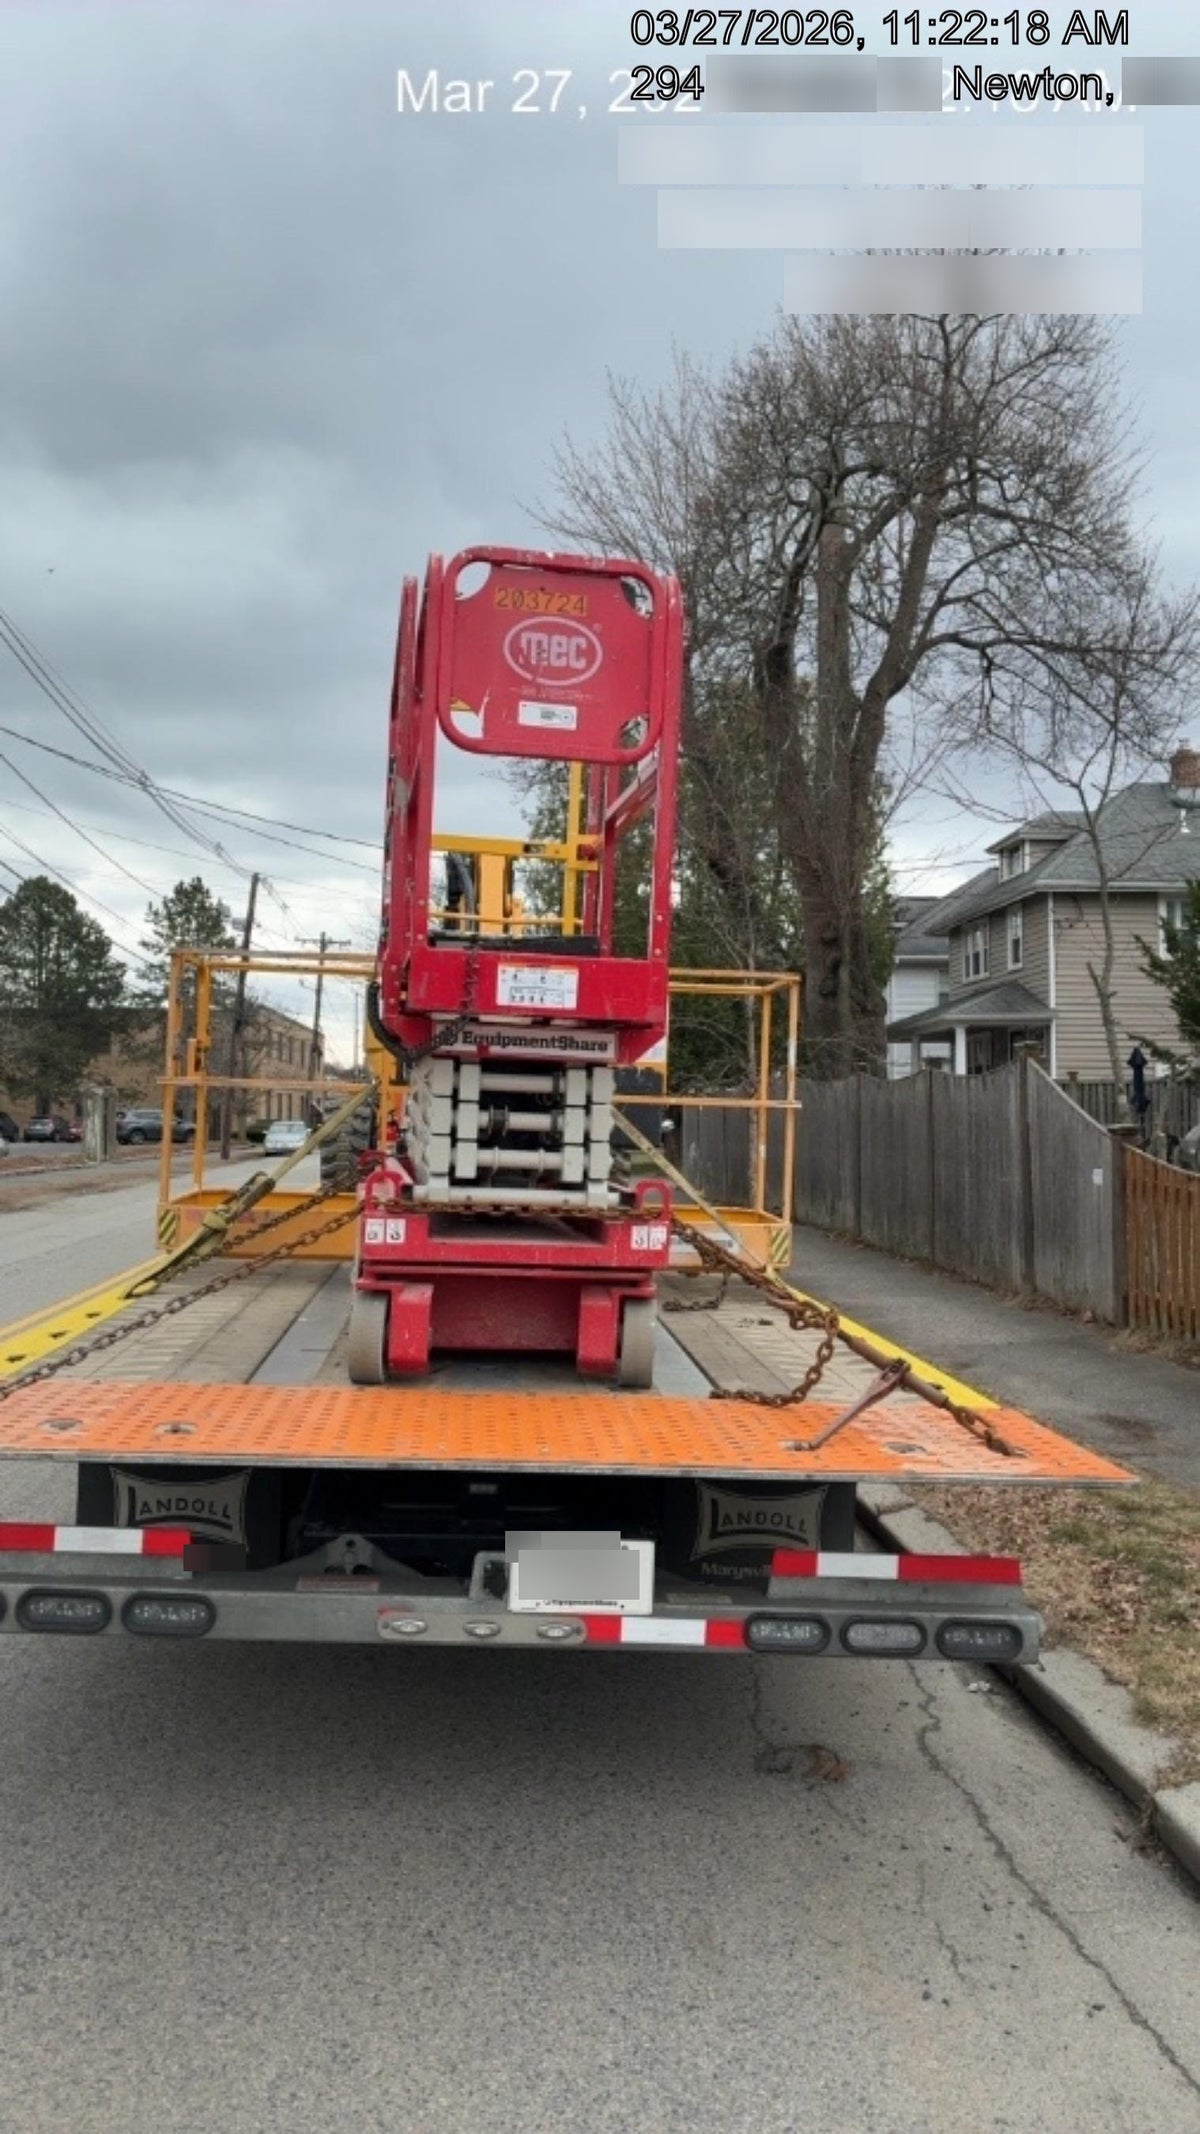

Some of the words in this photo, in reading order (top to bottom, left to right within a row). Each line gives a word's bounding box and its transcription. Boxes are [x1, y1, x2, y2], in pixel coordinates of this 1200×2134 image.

[496, 586, 585, 614] 203724
[127, 1485, 233, 1531] LANDOLL
[709, 1497, 810, 1546] LANDOLL
